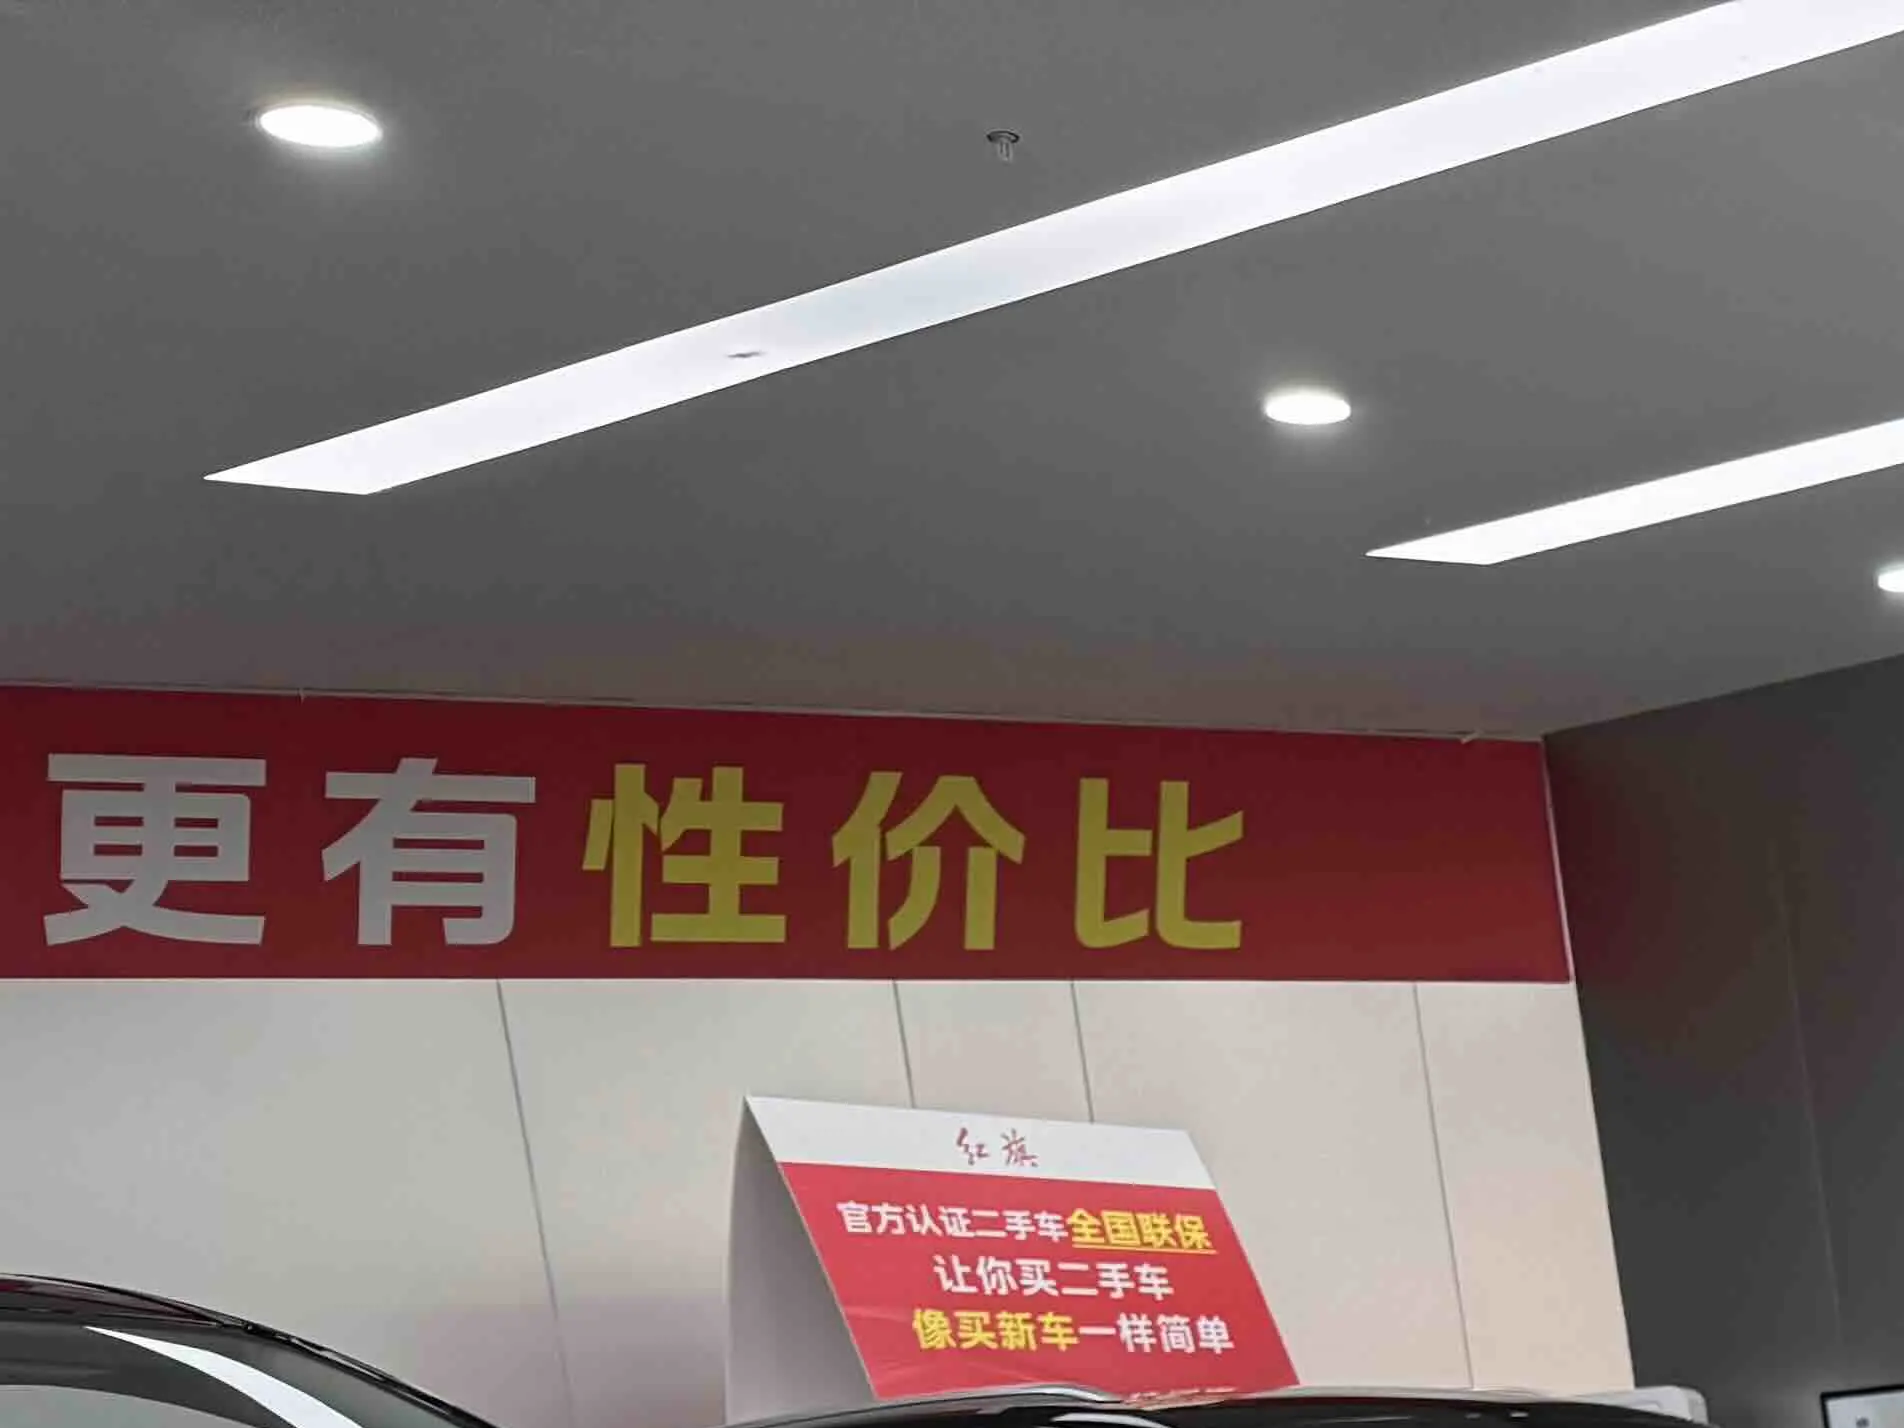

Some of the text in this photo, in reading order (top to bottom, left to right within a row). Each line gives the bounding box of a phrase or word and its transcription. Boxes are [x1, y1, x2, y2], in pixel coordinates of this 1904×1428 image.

[43, 753, 1245, 949] 更有性价比
[954, 1127, 1040, 1168] 红旗
[836, 1200, 1211, 1250] 官方认证二手车全国联保
[933, 1256, 1175, 1301] 让你买二手车
[912, 1307, 1236, 1356] 像买新车一样简单
